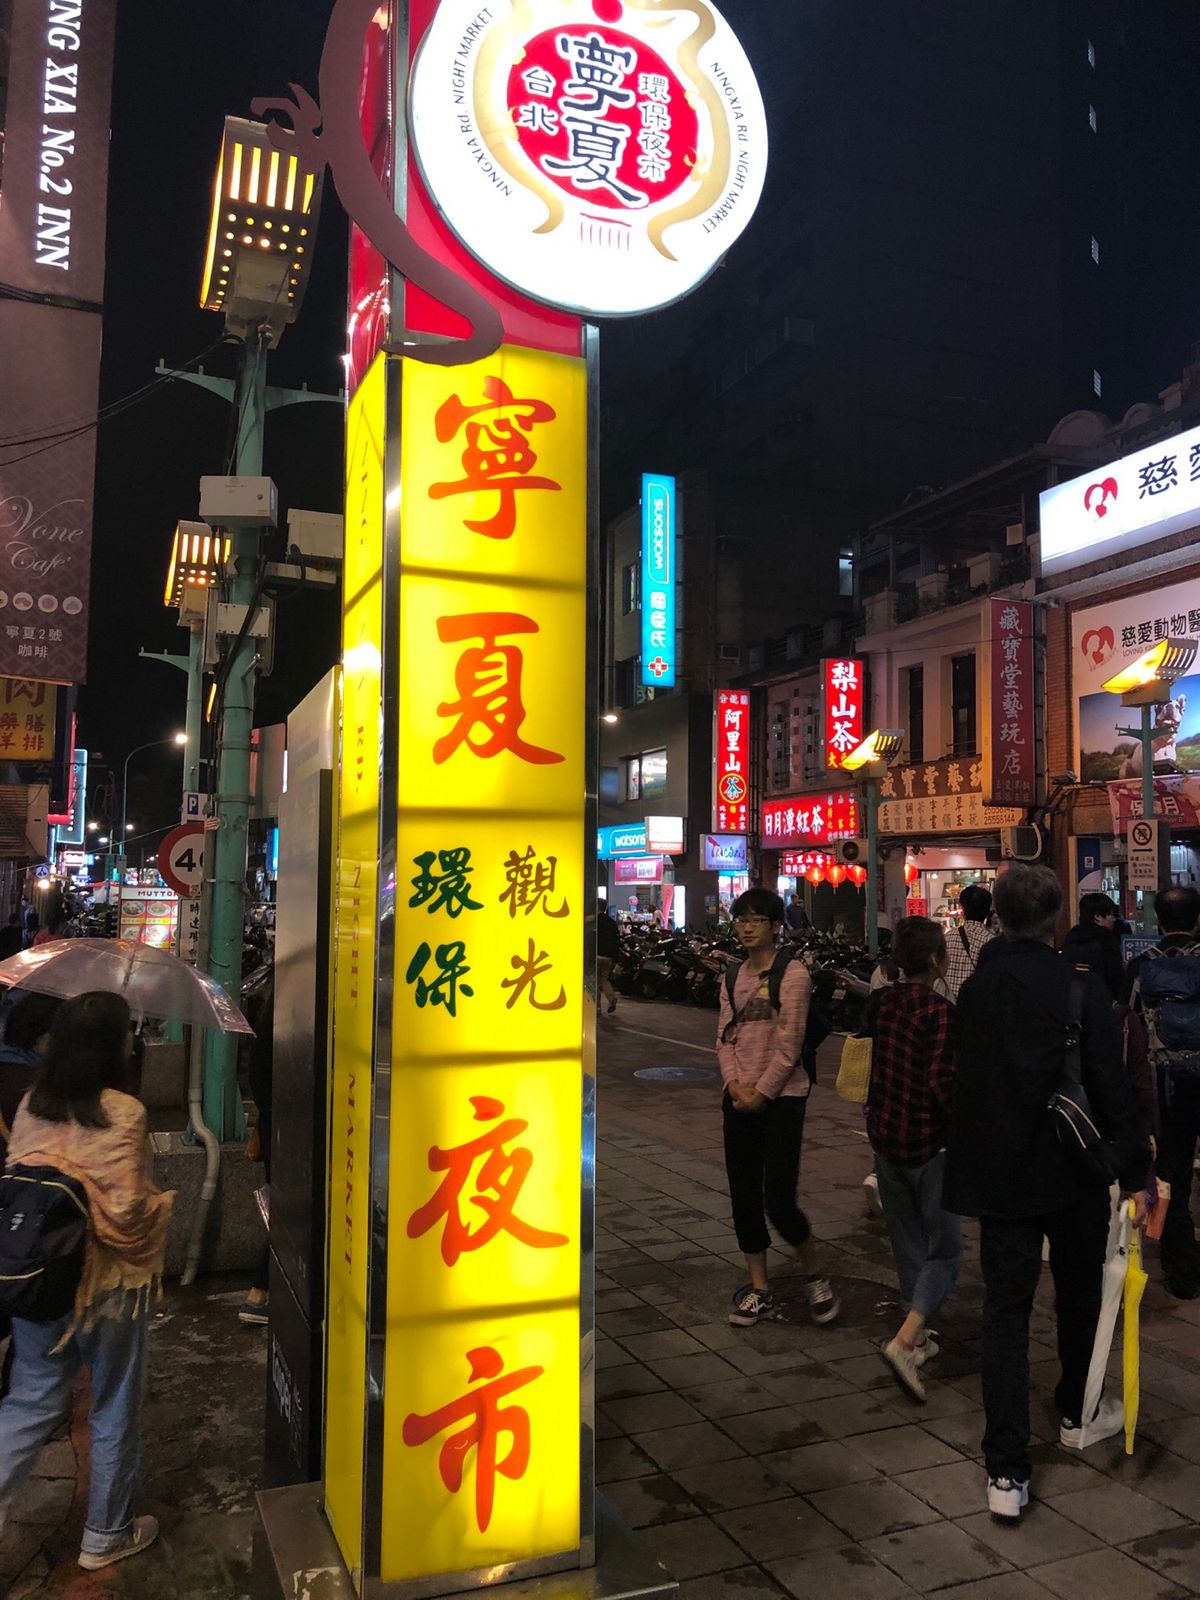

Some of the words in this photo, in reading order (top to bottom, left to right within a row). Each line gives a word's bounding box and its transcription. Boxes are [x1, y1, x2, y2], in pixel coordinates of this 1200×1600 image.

[48, 0, 82, 50] NG
[457, 7, 493, 59] MARKET
[44, 57, 79, 114] XIA
[452, 59, 466, 104] NIGHT
[523, 69, 557, 131] 台北
[710, 62, 744, 120] NINGXIA
[544, 36, 642, 203] 寧夏
[641, 75, 669, 180] 環保夜市
[40, 128, 75, 195] No.2
[467, 138, 513, 196] NINGXIA
[733, 150, 749, 190] NIGHT
[35, 203, 71, 270] INN
[702, 189, 740, 234] MARKET
[1138, 443, 1200, 501] 慈
[653, 498, 665, 570] watsons
[18, 645, 49, 658] 咖啡
[829, 661, 860, 752] 梨山茶
[188, 798, 198, 813] P
[785, 864, 811, 874] 日月潭
[406, 847, 484, 1018] 環保
[499, 845, 570, 1011] 觀光
